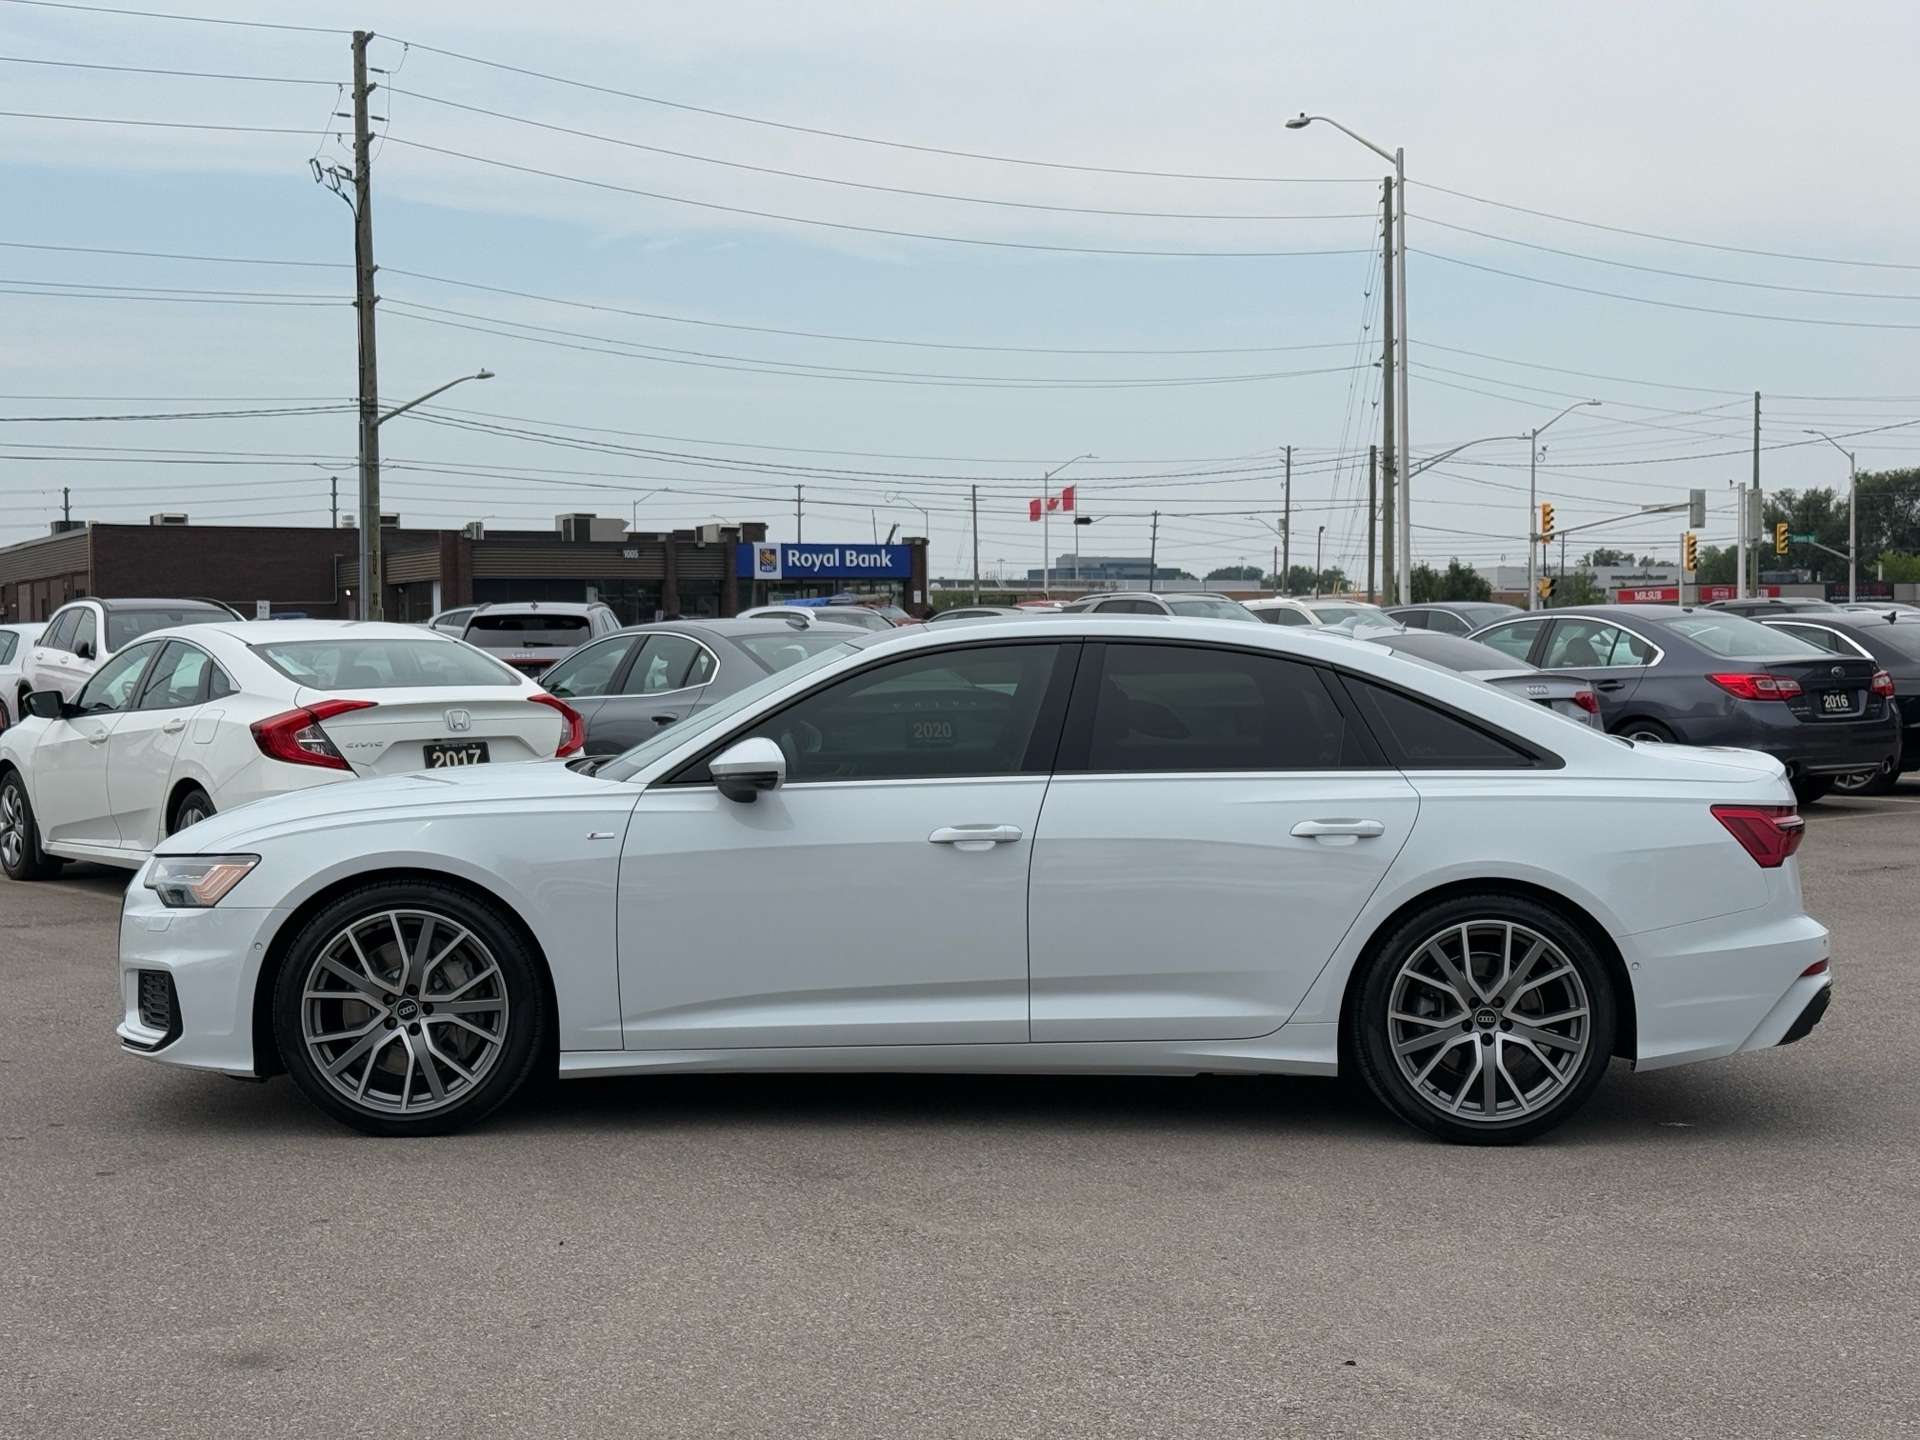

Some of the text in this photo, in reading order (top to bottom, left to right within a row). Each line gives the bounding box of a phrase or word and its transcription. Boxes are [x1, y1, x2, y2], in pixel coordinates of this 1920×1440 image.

[787, 548, 893, 572] Royal Bank
[1823, 694, 1849, 708] 2016
[912, 721, 953, 738] 2020
[432, 749, 481, 768] 2017
